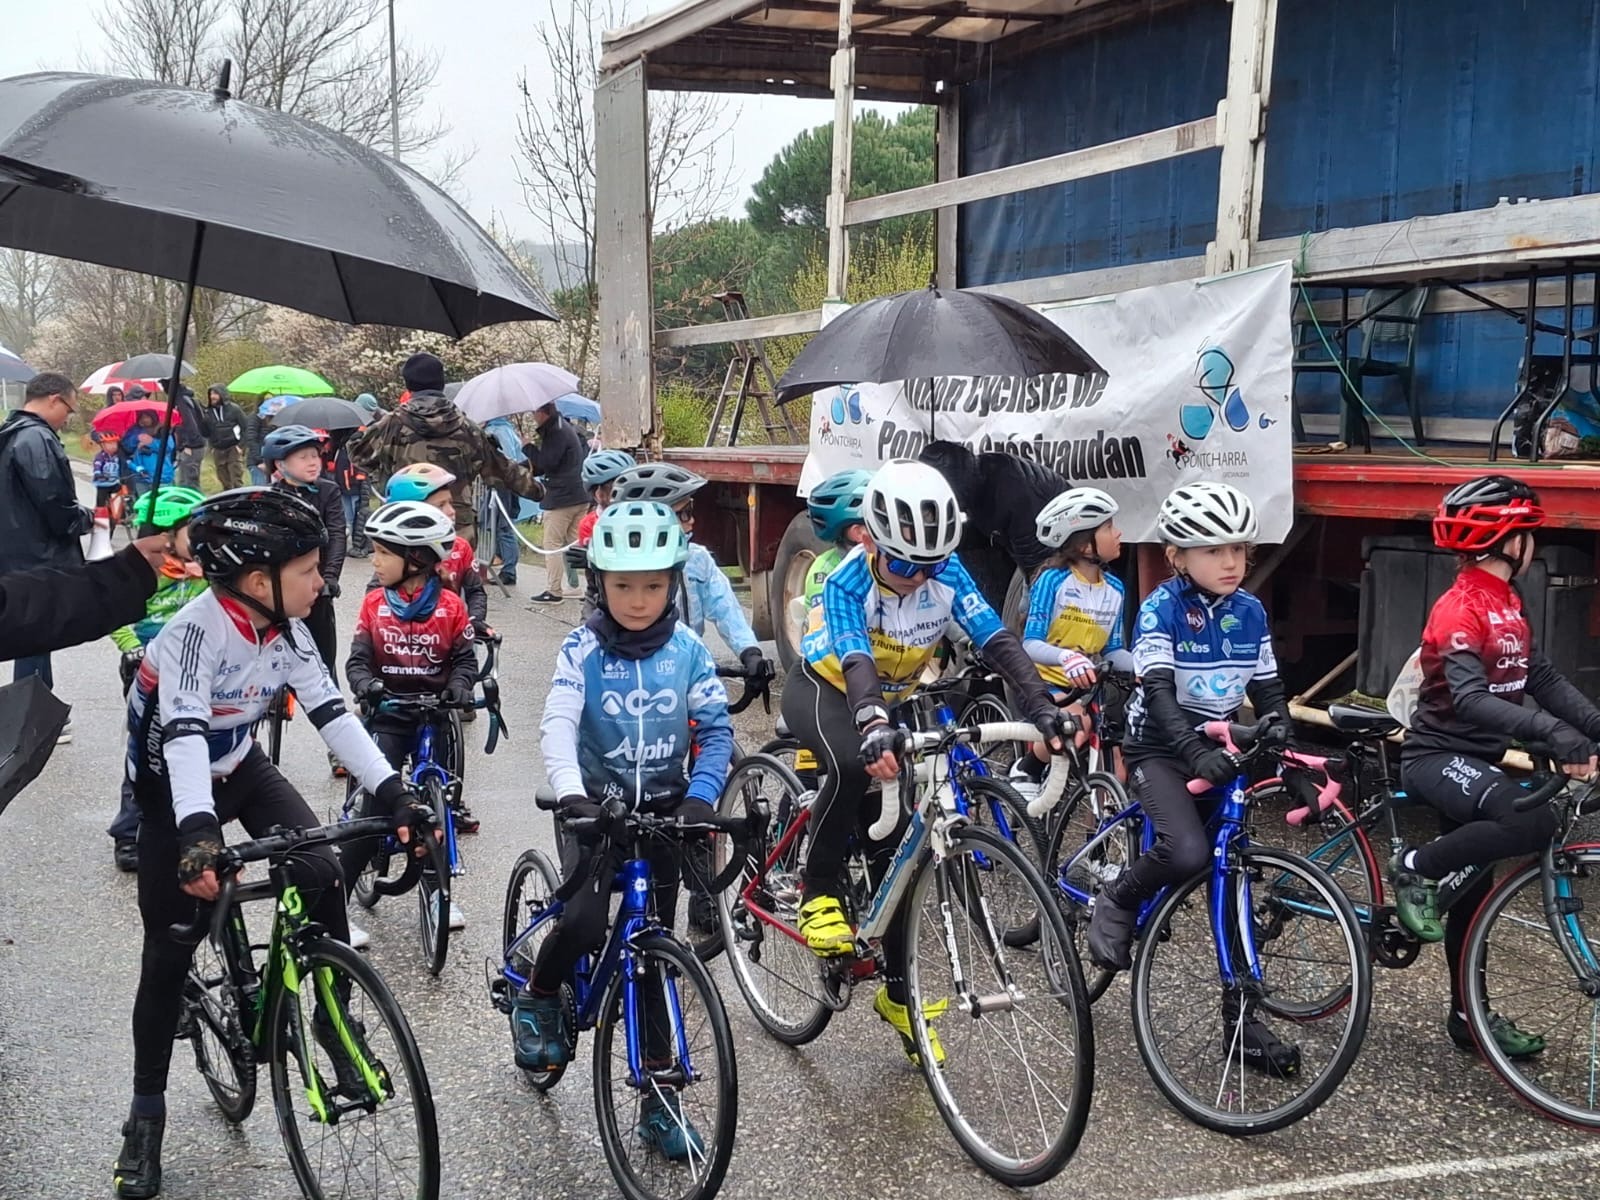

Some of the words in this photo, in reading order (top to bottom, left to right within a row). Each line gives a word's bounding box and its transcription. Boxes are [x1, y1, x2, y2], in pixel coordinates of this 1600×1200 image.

[1181, 451, 1248, 469] PONTCHARRA
[383, 643, 443, 664] CHAZAL
[210, 688, 243, 700] rédit
[603, 734, 676, 766] Alphi
[1449, 864, 1474, 890] TEAM
[941, 901, 963, 982] LAPIERRE
